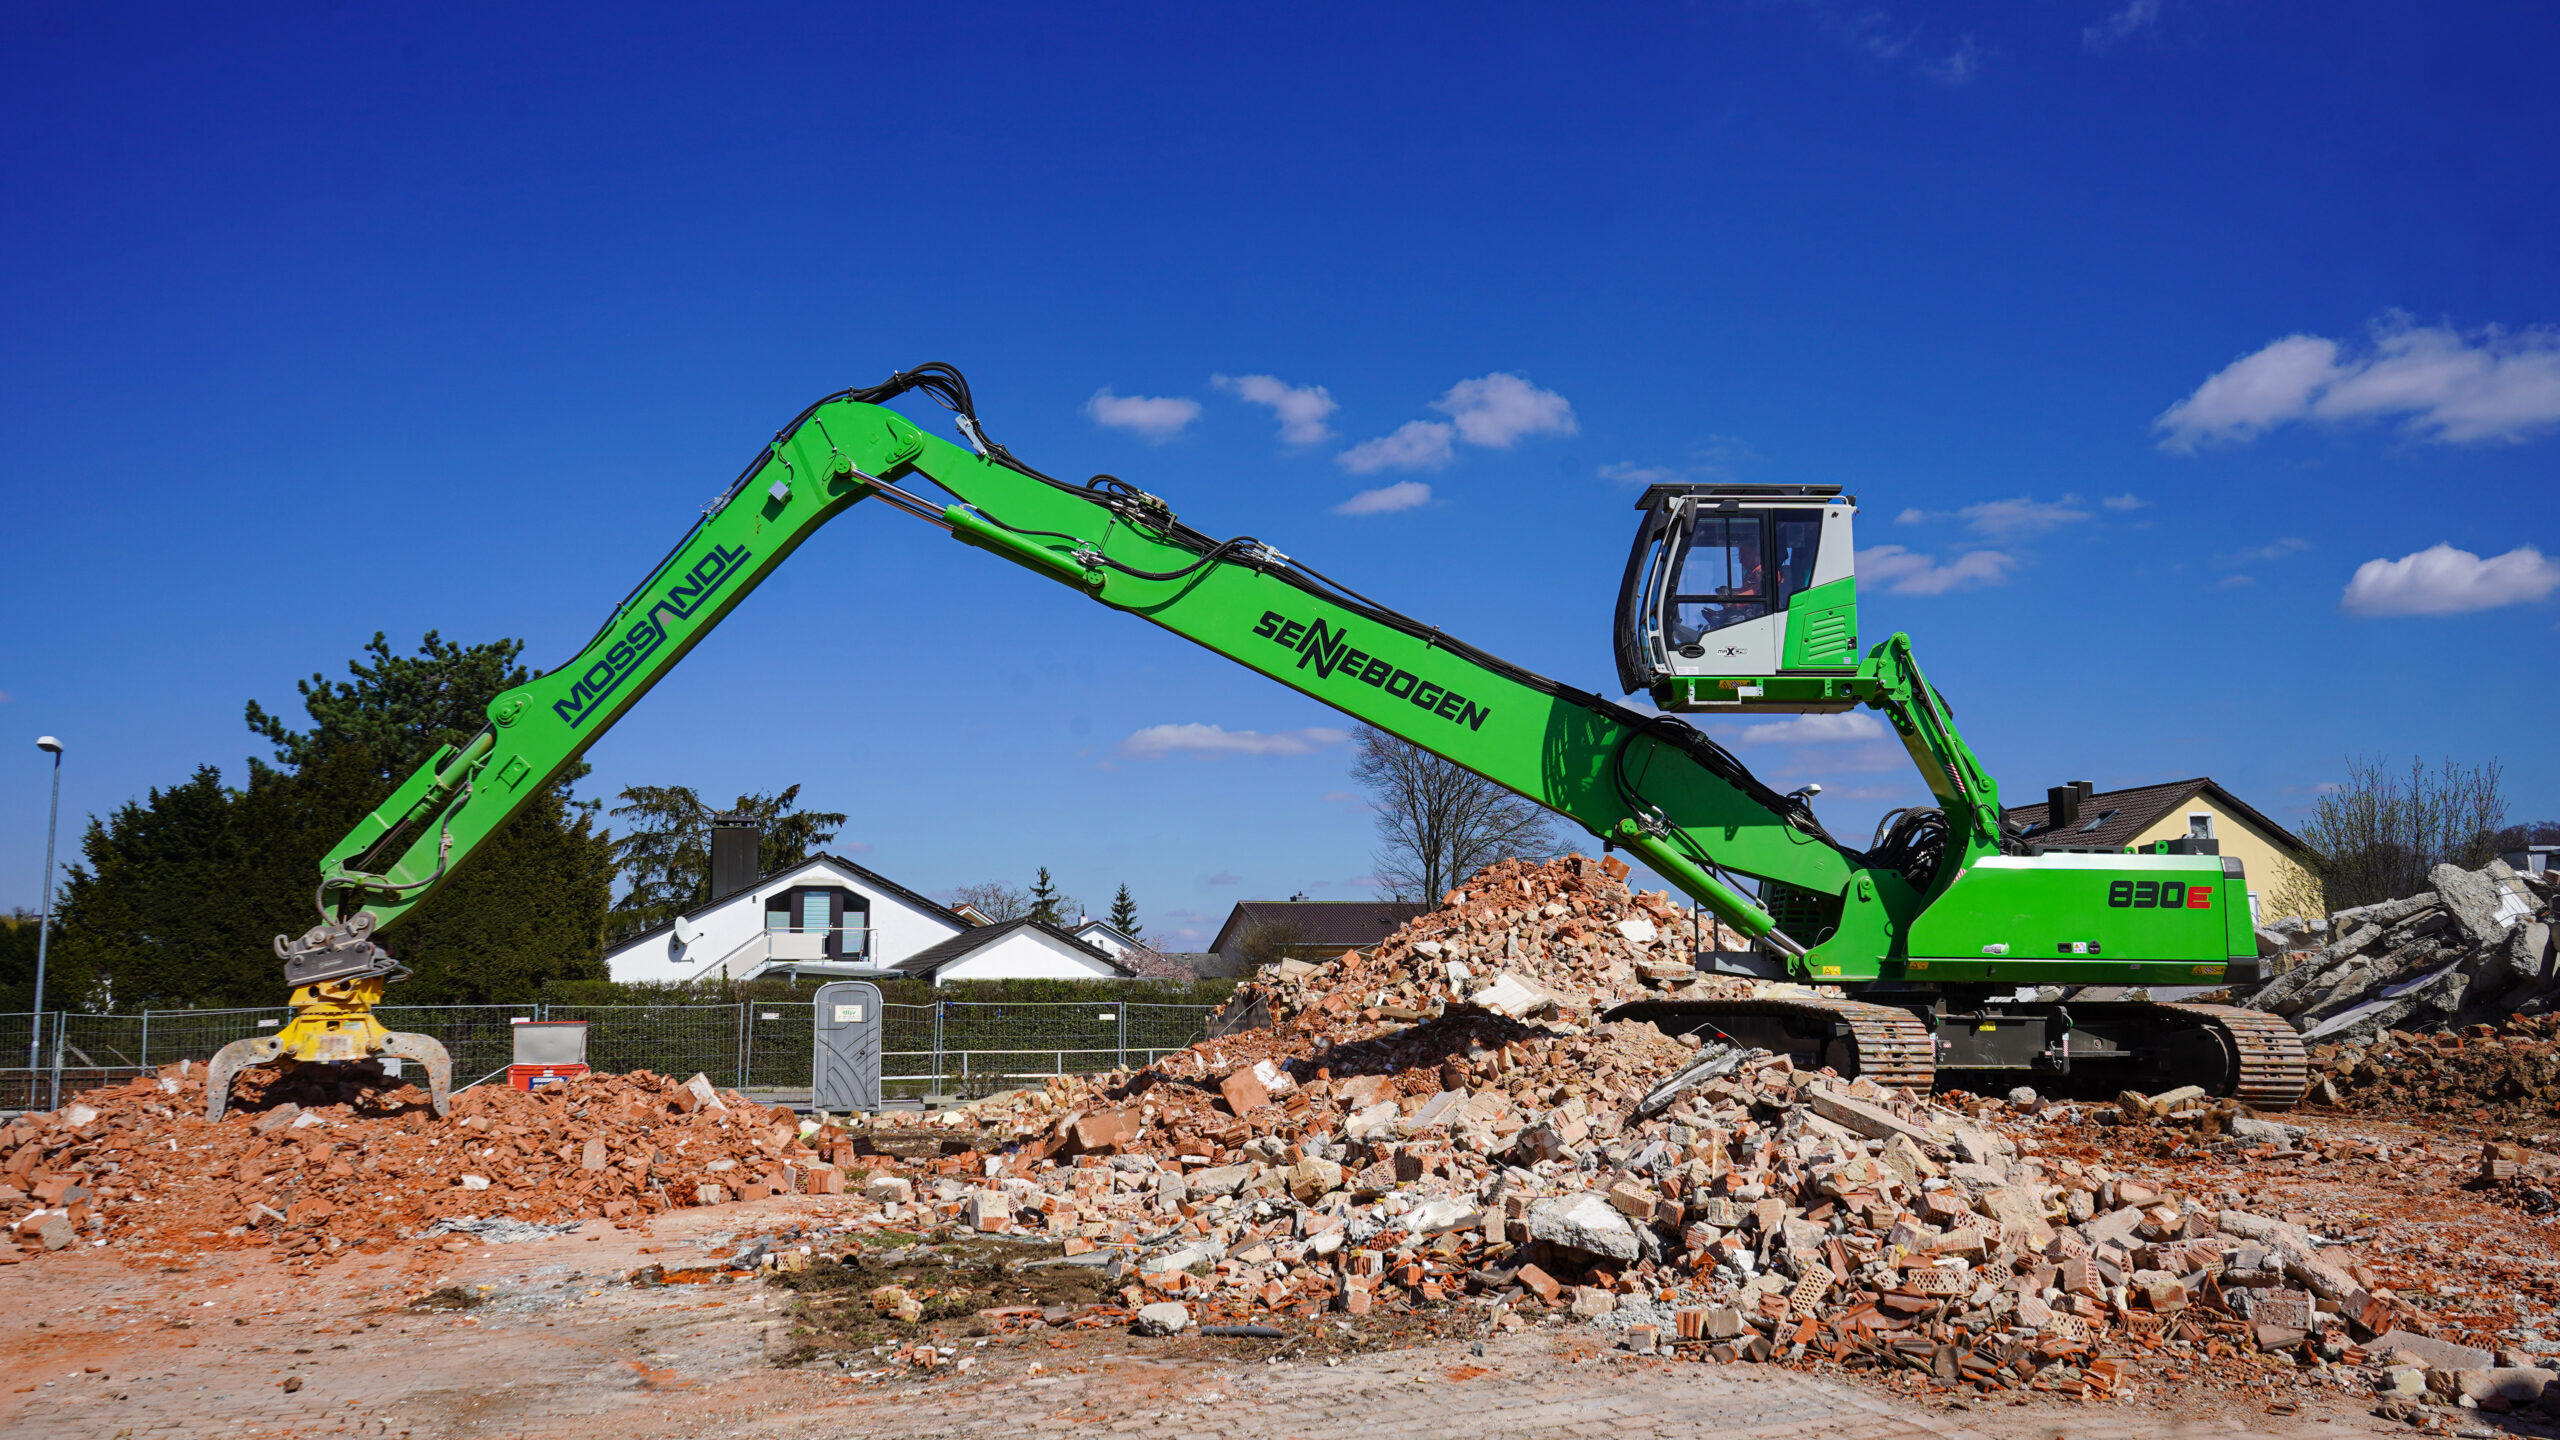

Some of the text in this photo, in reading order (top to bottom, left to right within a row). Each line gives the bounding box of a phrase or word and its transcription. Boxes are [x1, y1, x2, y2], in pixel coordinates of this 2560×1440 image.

[552, 544, 752, 729] MOSSANDL
[1252, 610, 1491, 732] SENNEBOGEN
[2108, 880, 2213, 909] 830E
